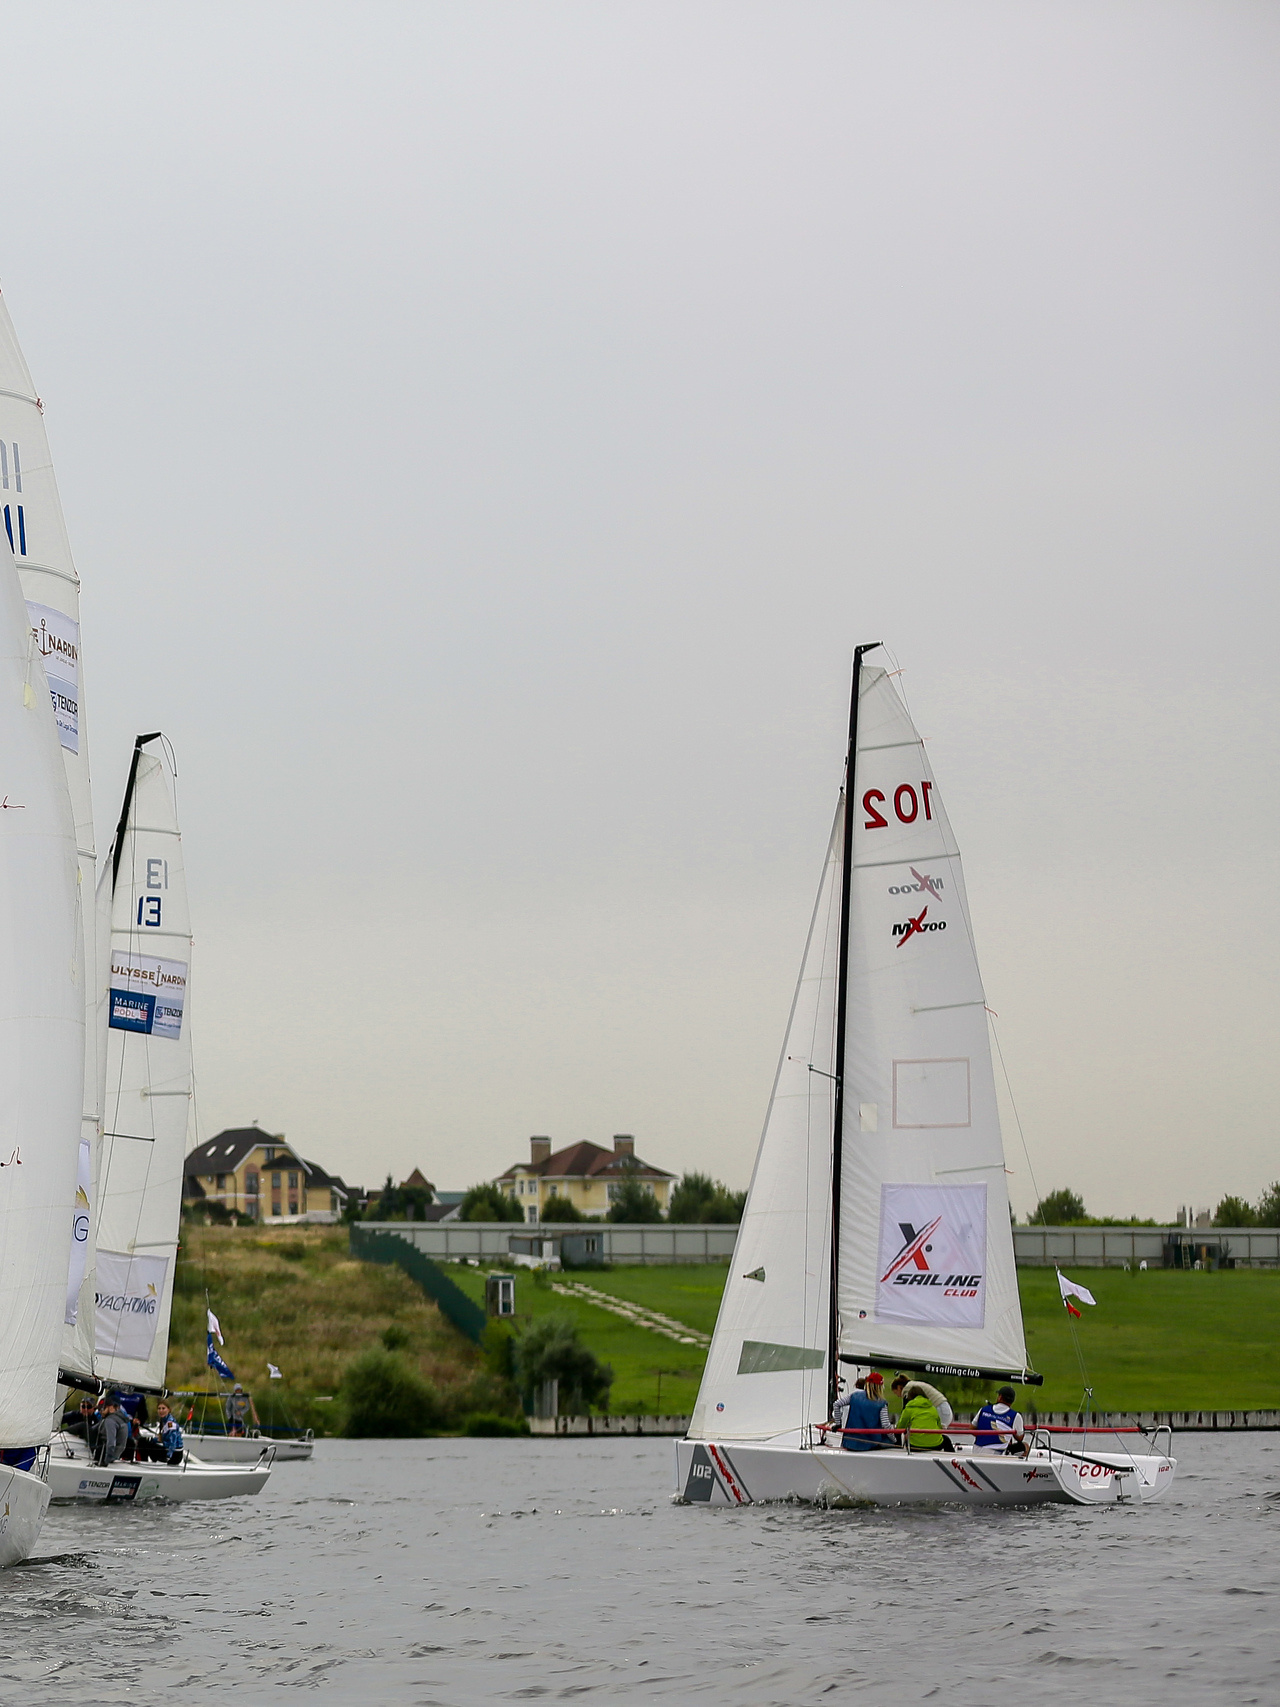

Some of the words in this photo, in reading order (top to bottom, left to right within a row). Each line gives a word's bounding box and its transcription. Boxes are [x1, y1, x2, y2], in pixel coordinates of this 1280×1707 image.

[4, 504, 27, 556] 11
[137, 895, 161, 927] 13
[891, 905, 946, 948] MX700
[111, 964, 156, 980] ULYSSE
[161, 973, 186, 986] NARDIN
[114, 997, 149, 1010] MARINE
[114, 1007, 136, 1018] POOL
[163, 1007, 183, 1018] TENZOR
[893, 1274, 982, 1287] SAILING
[943, 1288, 978, 1297] CLUB
[95, 1292, 157, 1314] YACHTING
[925, 1363, 980, 1377] @xsailingclub
[692, 1463, 712, 1479] 102
